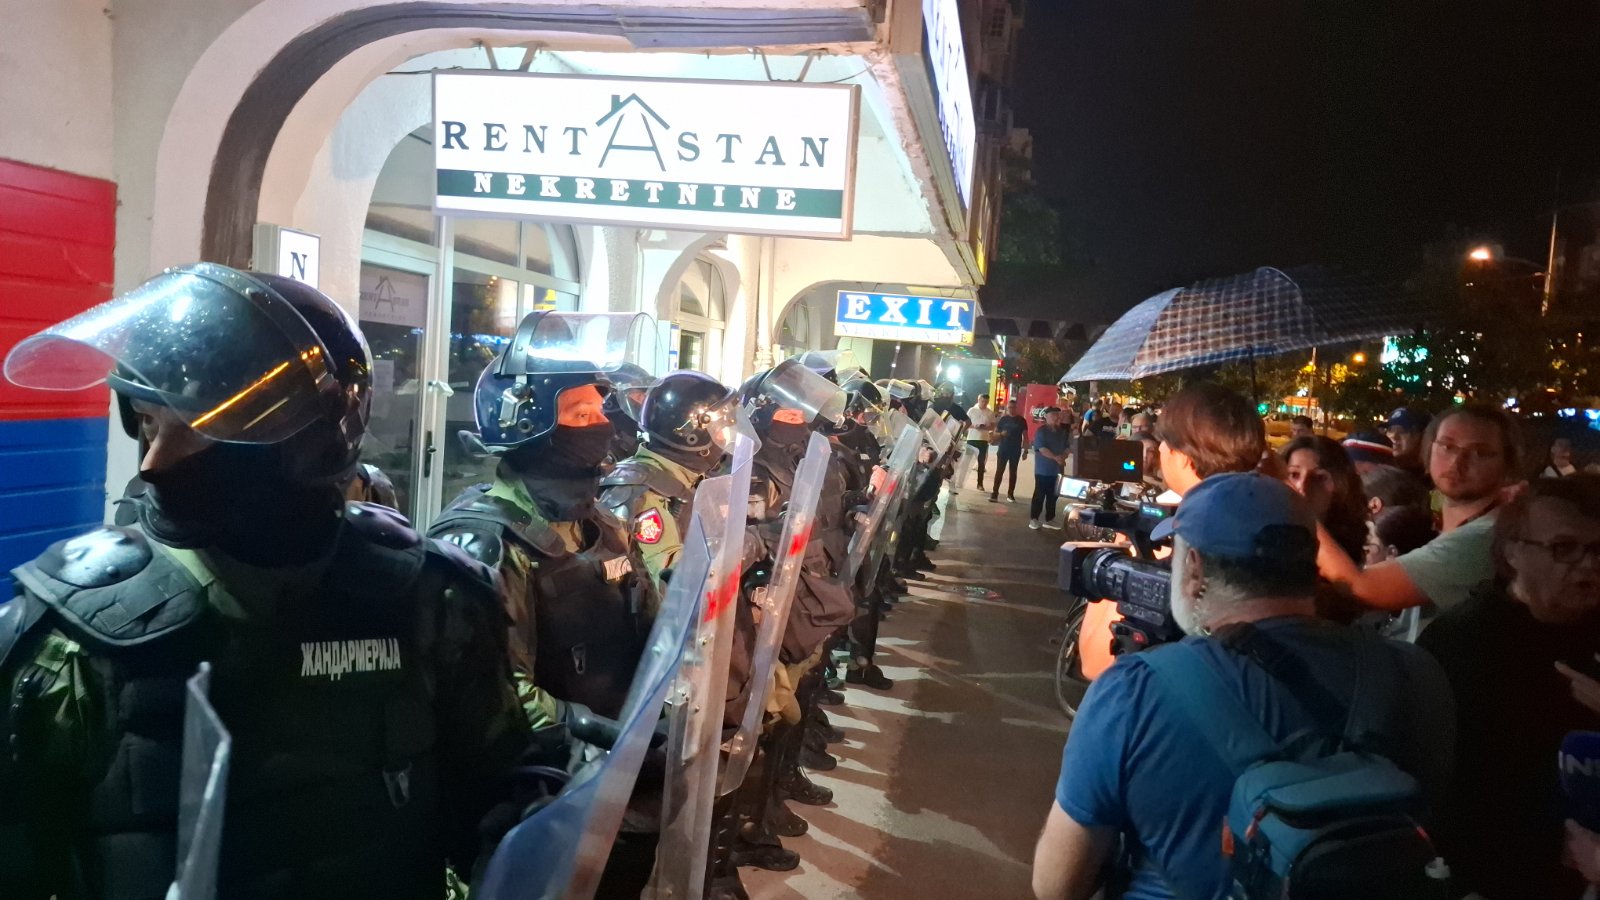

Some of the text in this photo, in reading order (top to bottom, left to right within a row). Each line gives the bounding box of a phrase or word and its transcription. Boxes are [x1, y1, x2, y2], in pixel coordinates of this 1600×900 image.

[474, 172, 797, 210] NEKRETNINE
[844, 294, 969, 327] EXIT
[301, 638, 401, 681] ЖАНДАРМЕРИЈА
